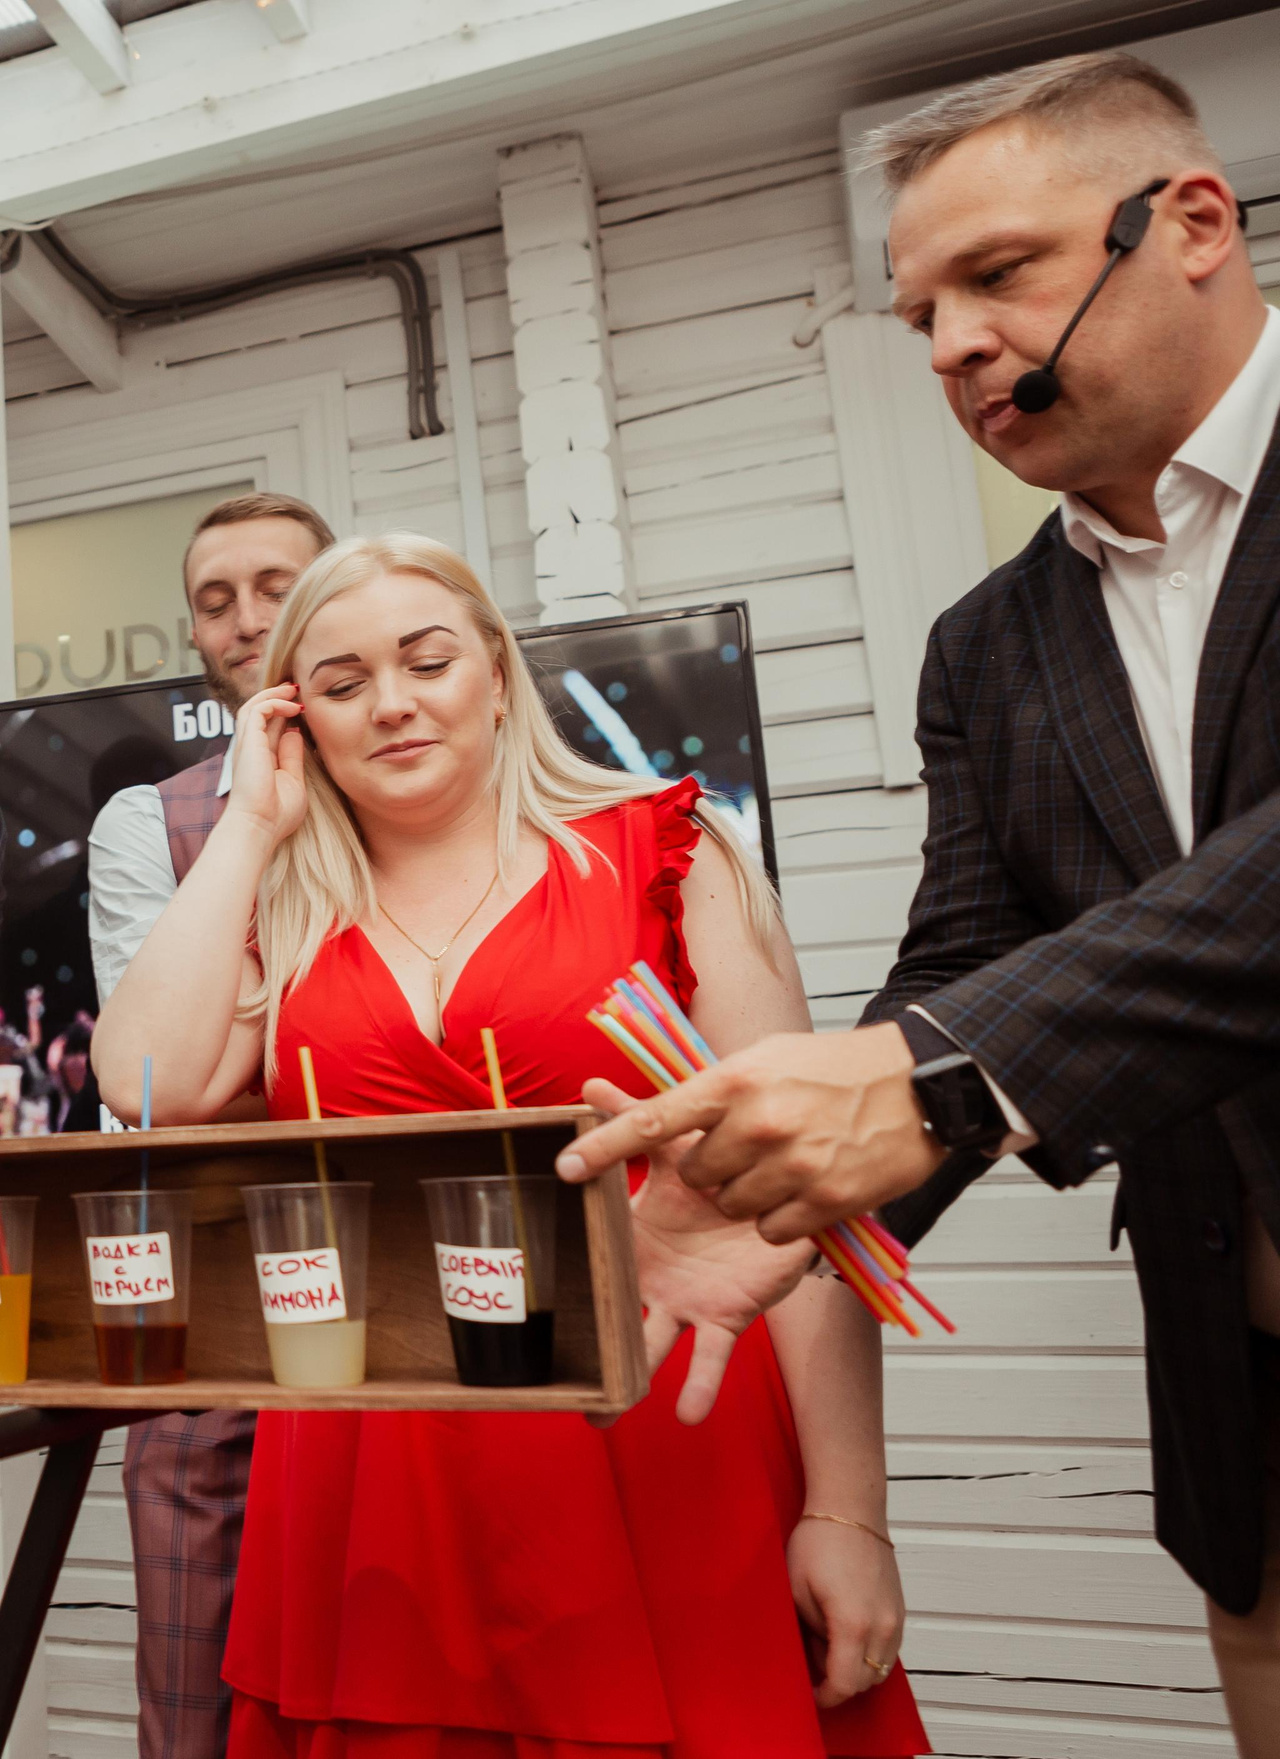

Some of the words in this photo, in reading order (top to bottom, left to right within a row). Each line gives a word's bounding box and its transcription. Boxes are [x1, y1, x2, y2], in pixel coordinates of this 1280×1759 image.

[92, 1241, 161, 1259] ВОДКА
[262, 1254, 329, 1277] СОК
[445, 1283, 513, 1310] СОУС
